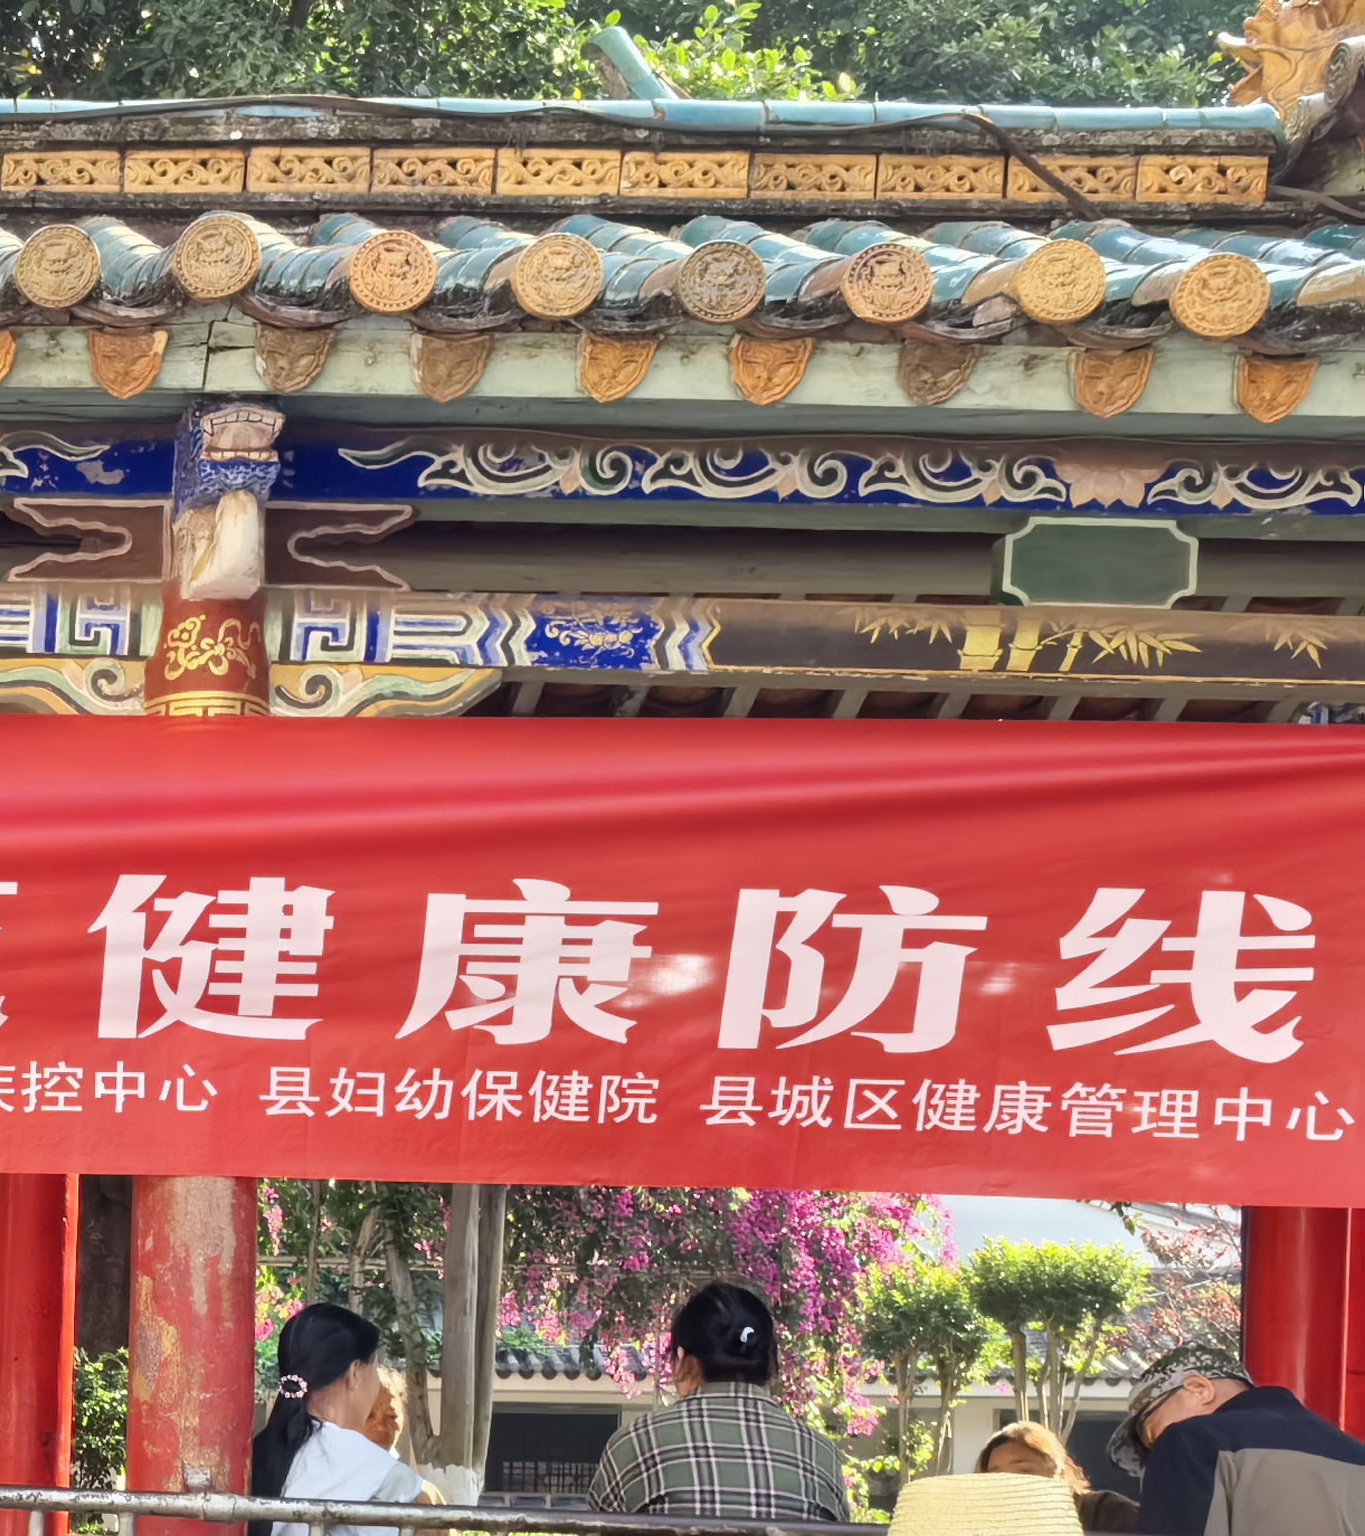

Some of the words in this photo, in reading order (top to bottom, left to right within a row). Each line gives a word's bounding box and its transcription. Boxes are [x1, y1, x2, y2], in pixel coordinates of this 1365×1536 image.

[258, 1065, 661, 1125] 县妇幼保健院
[699, 1074, 1357, 1143] 县城区健康管理中心
